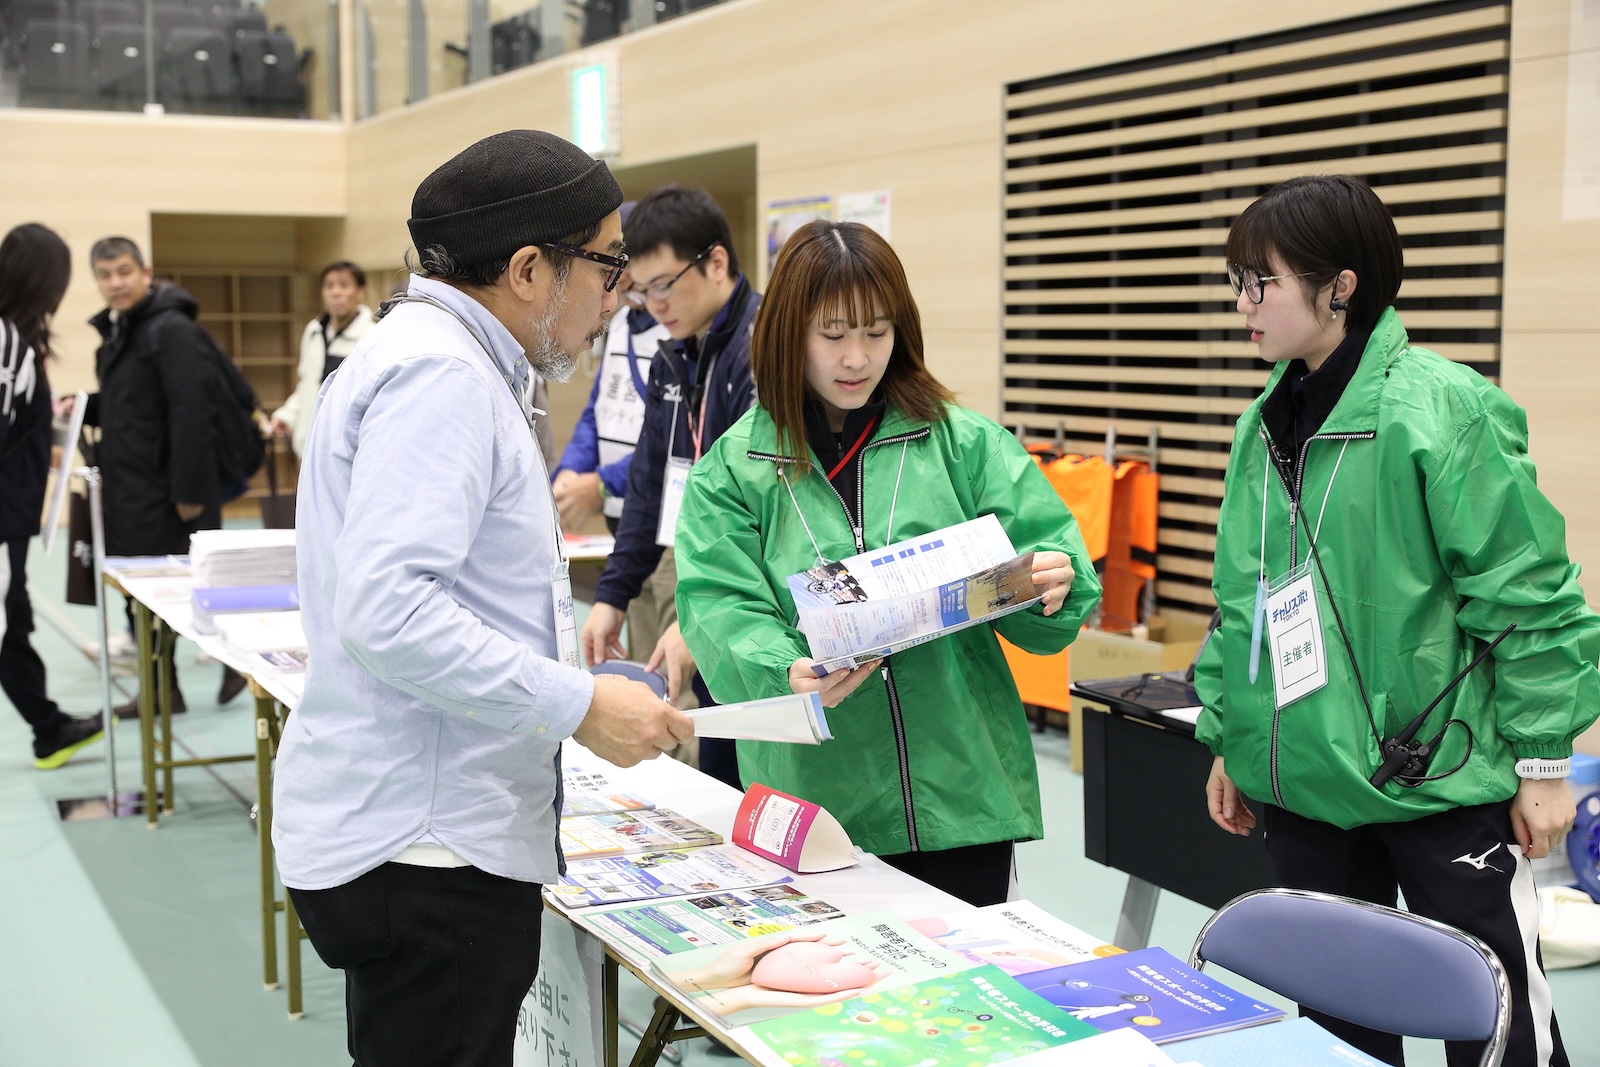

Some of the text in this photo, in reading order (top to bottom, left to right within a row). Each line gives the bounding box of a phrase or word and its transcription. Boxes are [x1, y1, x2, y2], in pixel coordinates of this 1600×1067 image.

[1272, 589, 1308, 623] チャレスポ!
[1283, 608, 1300, 623] TOKYO
[1283, 640, 1312, 667] 主催者
[871, 923, 947, 968] 障害者スポーツの
[876, 943, 909, 960] 手引き
